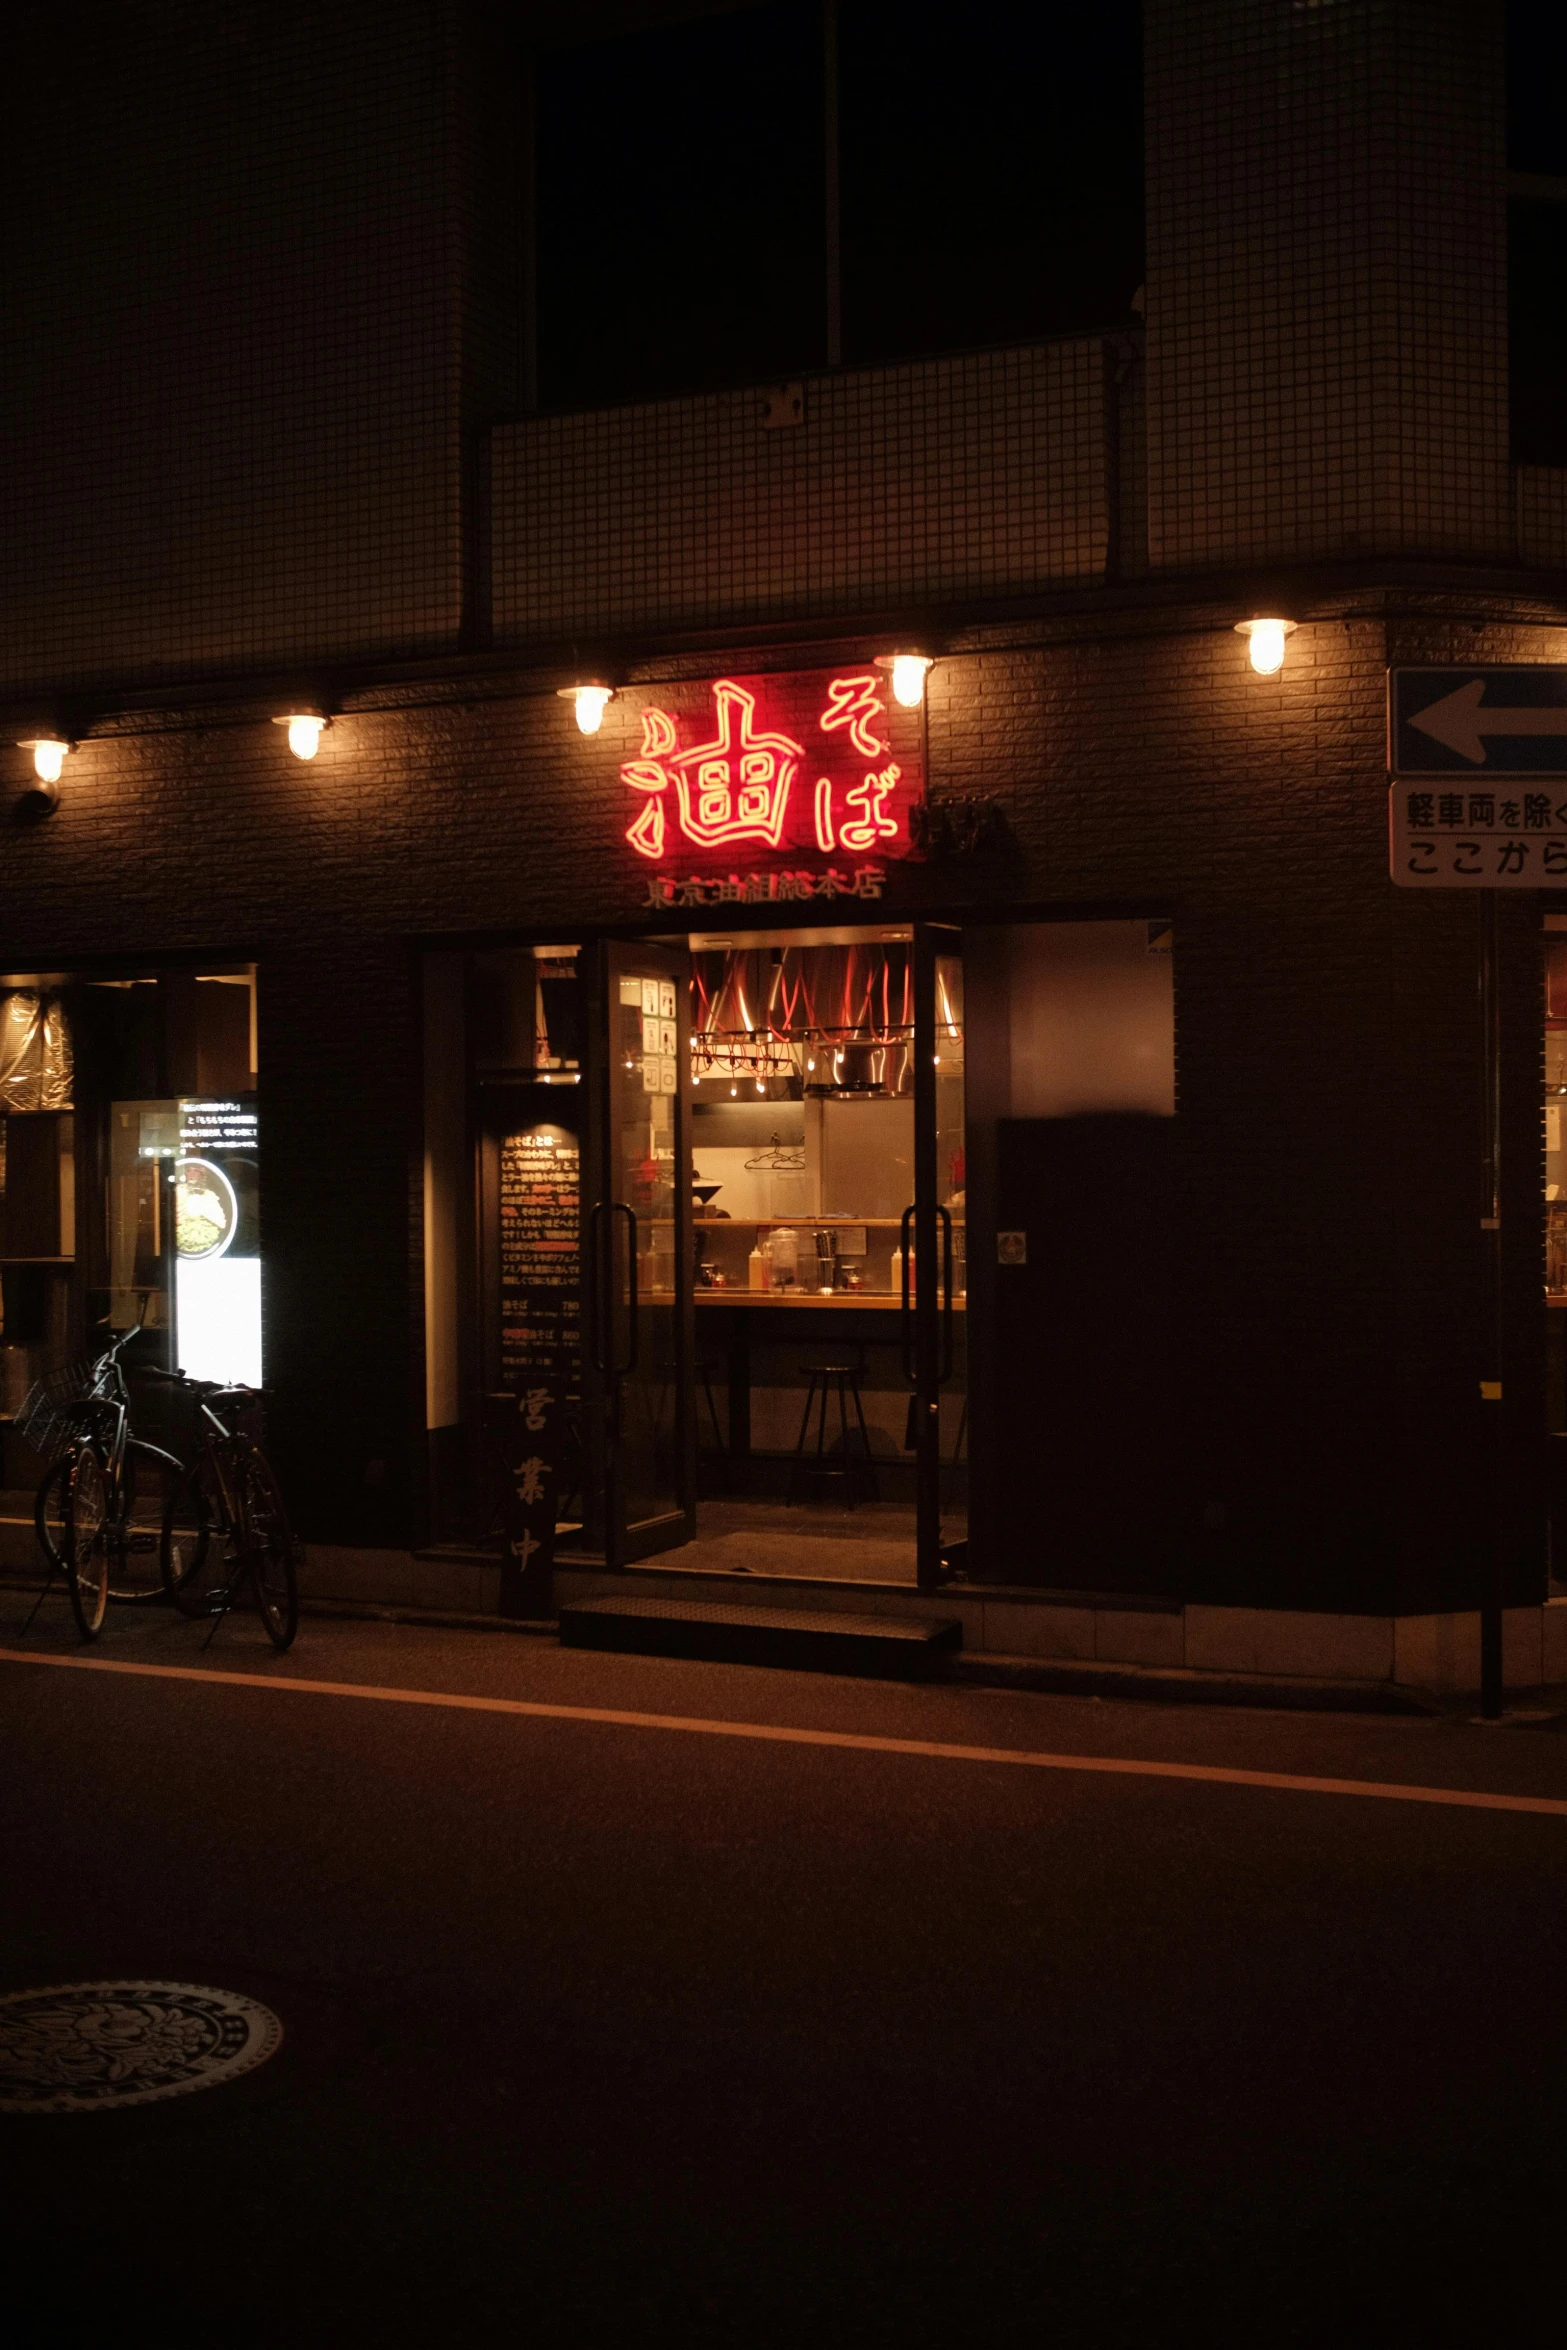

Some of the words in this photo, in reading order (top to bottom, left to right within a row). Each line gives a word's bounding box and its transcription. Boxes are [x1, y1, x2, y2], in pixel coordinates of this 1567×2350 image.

[619, 679, 807, 860] 油
[814, 674, 902, 853] そば
[1407, 792, 1567, 830] 軽車両を除く
[1408, 840, 1567, 874] ここから
[642, 864, 887, 910] 東京油組総本店
[511, 1387, 555, 1572] 営業中
